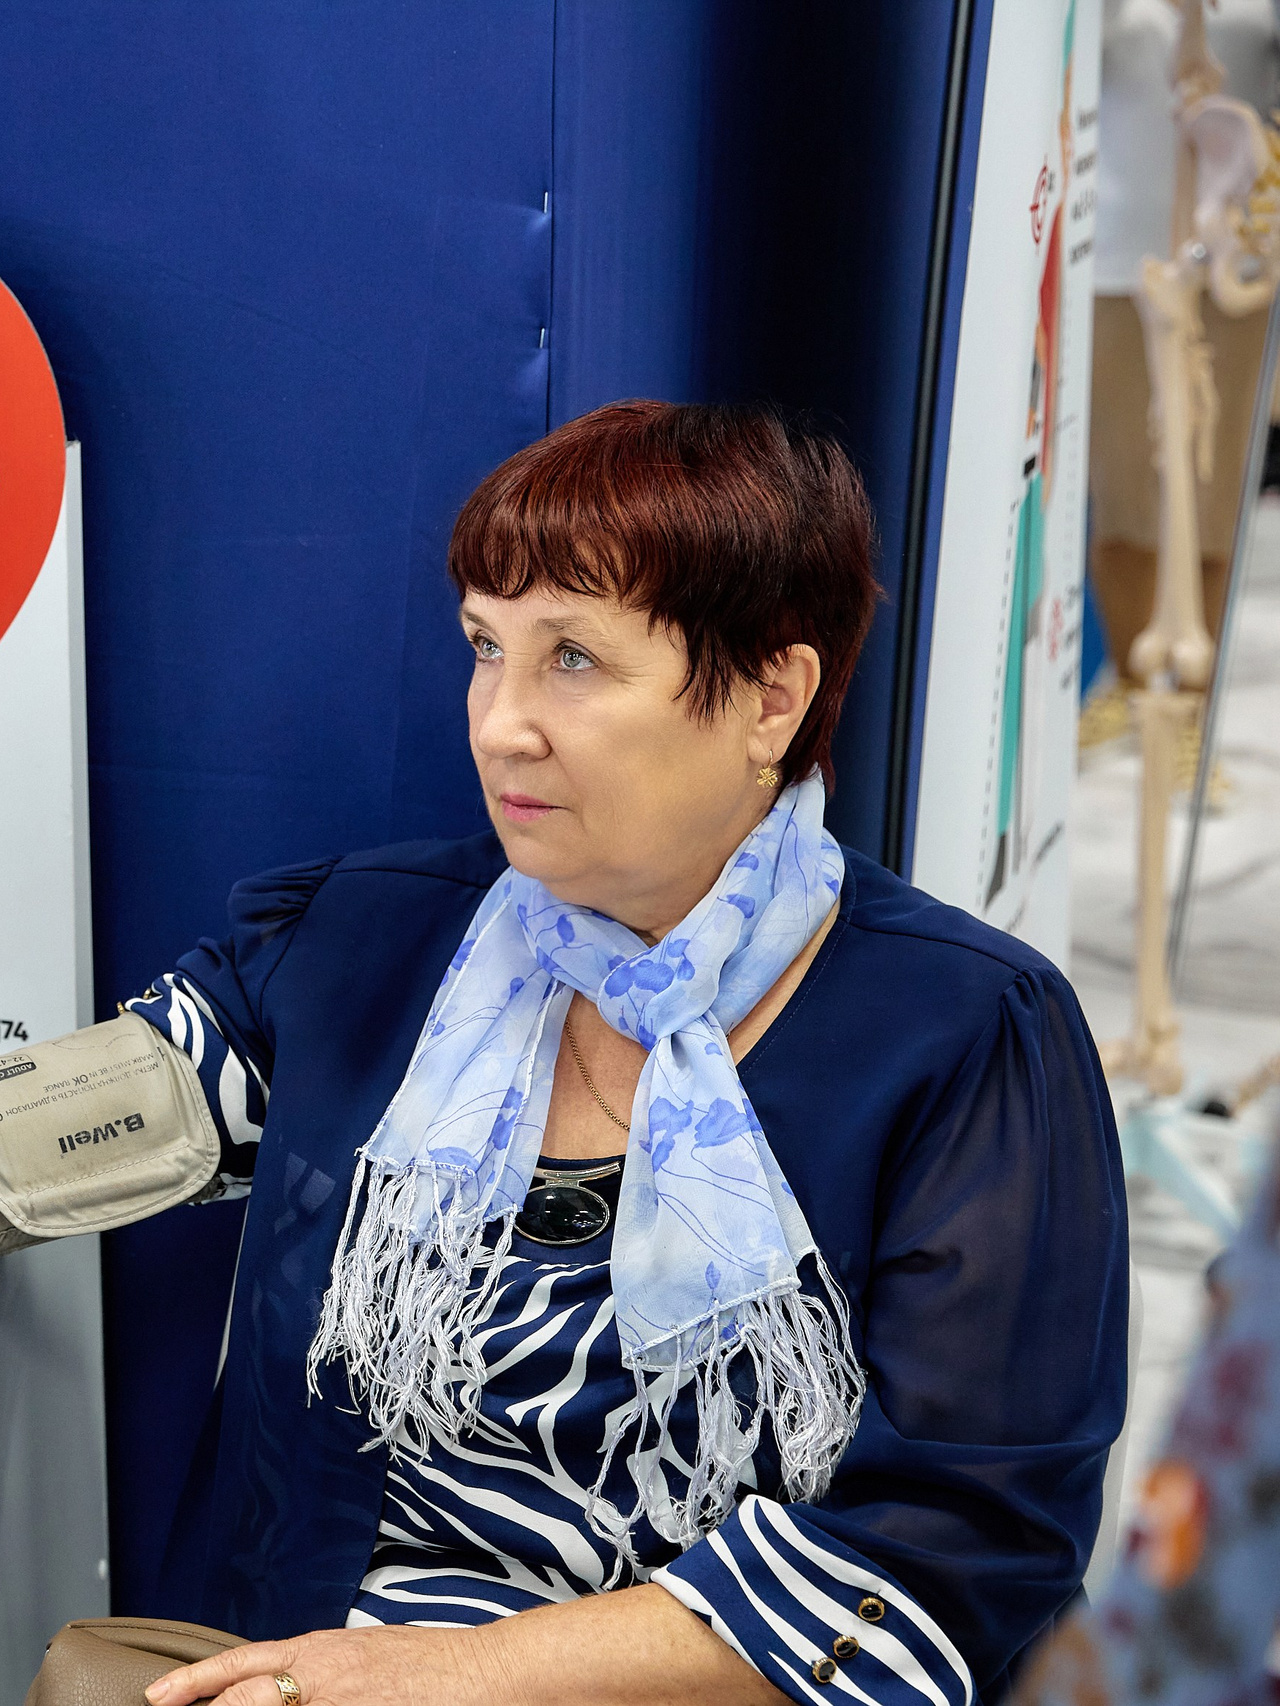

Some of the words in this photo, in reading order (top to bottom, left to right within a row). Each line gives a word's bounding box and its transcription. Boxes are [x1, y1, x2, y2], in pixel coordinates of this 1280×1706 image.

[7, 1063, 33, 1076] ADULT
[88, 1070, 98, 1079] IN
[97, 1067, 108, 1076] BE
[42, 1079, 71, 1093] RANGE
[71, 1074, 89, 1087] OK
[50, 1095, 57, 1103] В
[5, 1095, 51, 1117] ДИАПАЗОН
[58, 1113, 145, 1154] B.Well
